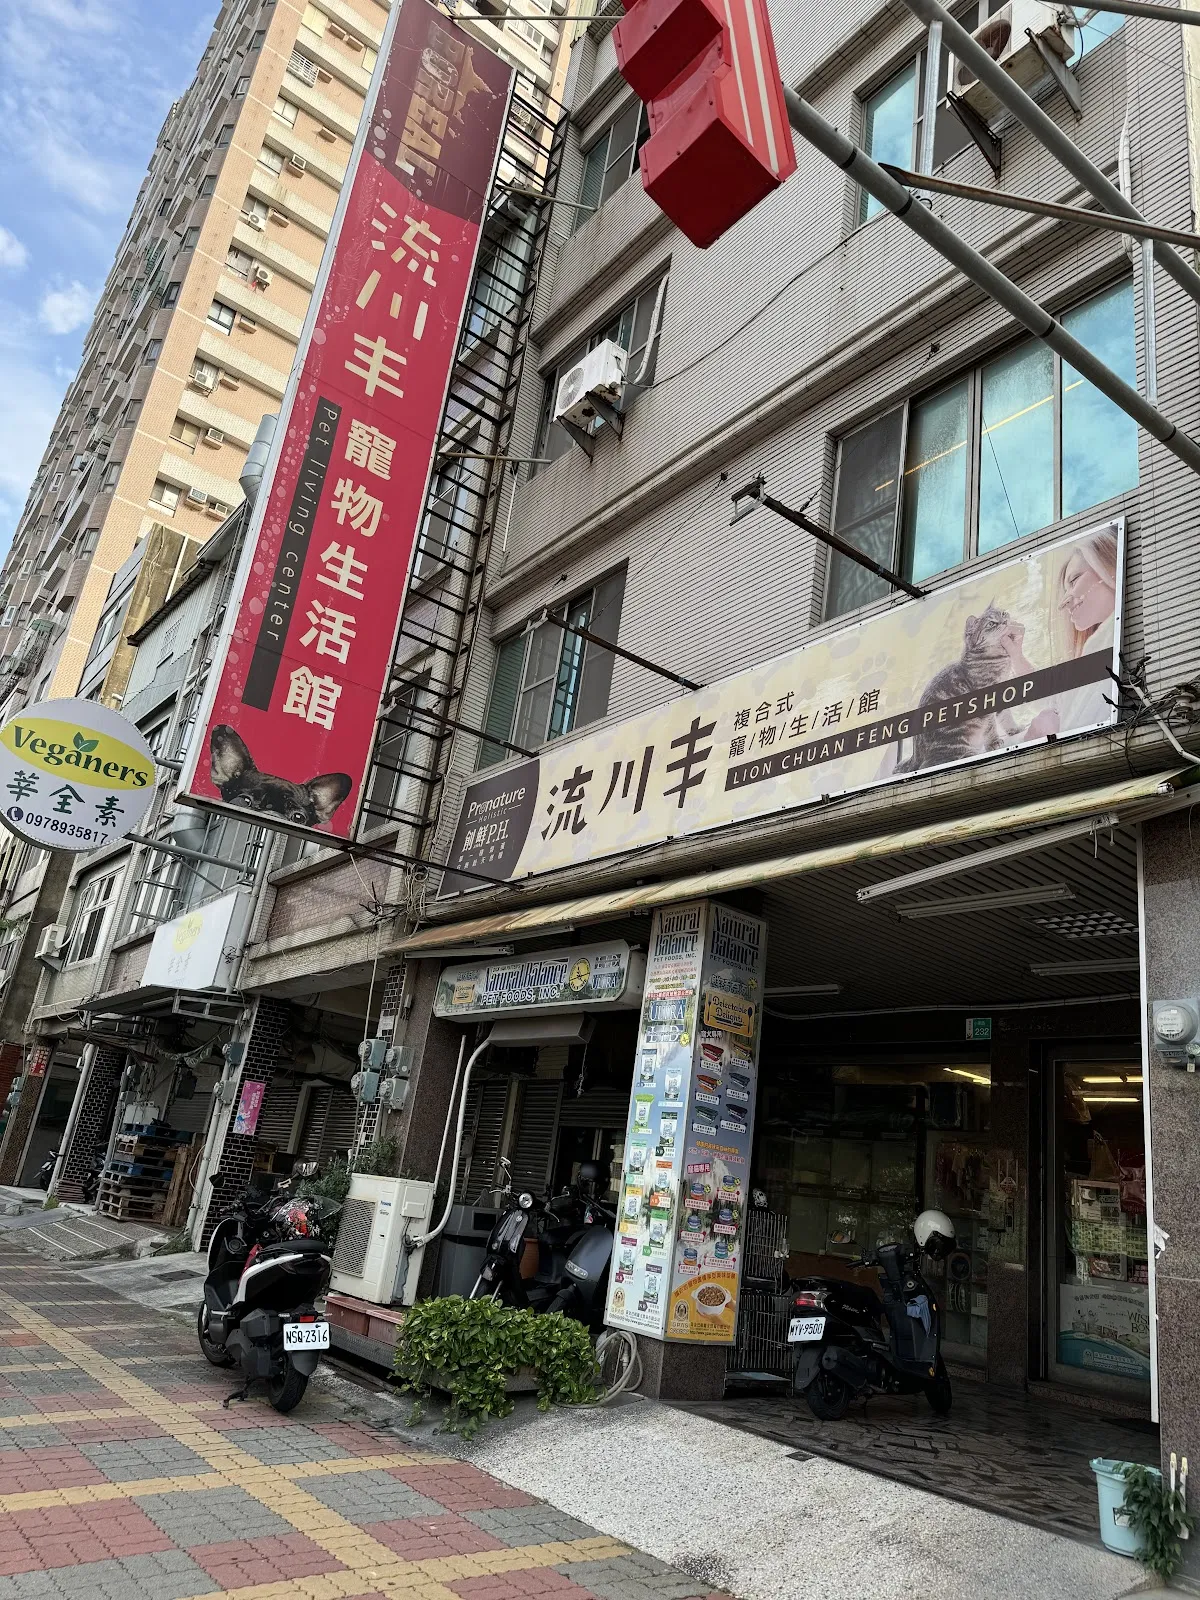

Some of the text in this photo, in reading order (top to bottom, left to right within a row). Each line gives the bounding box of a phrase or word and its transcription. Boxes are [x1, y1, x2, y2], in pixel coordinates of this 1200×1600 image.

[282, 201, 442, 731] 流川丰 寵物生活館
[266, 406, 338, 641] Pet living center
[733, 690, 795, 731] 複合式
[733, 680, 1035, 785] LION CHUAN FENG PETSHOP
[13, 725, 149, 787] Veganers
[541, 715, 718, 841] 流川丰
[467, 787, 526, 819] Pronature
[479, 807, 507, 823] Holistic
[25, 812, 109, 844] 0978935817
[657, 906, 701, 935] Natural
[714, 906, 761, 946] Natural
[481, 991, 500, 1006] PET
[500, 988, 535, 1003] FOODS,
[537, 985, 560, 999] INC.
[975, 1027, 990, 1036] 232
[1126, 1309, 1149, 1326] WIS
[285, 1329, 328, 1344] NSQ-2316
